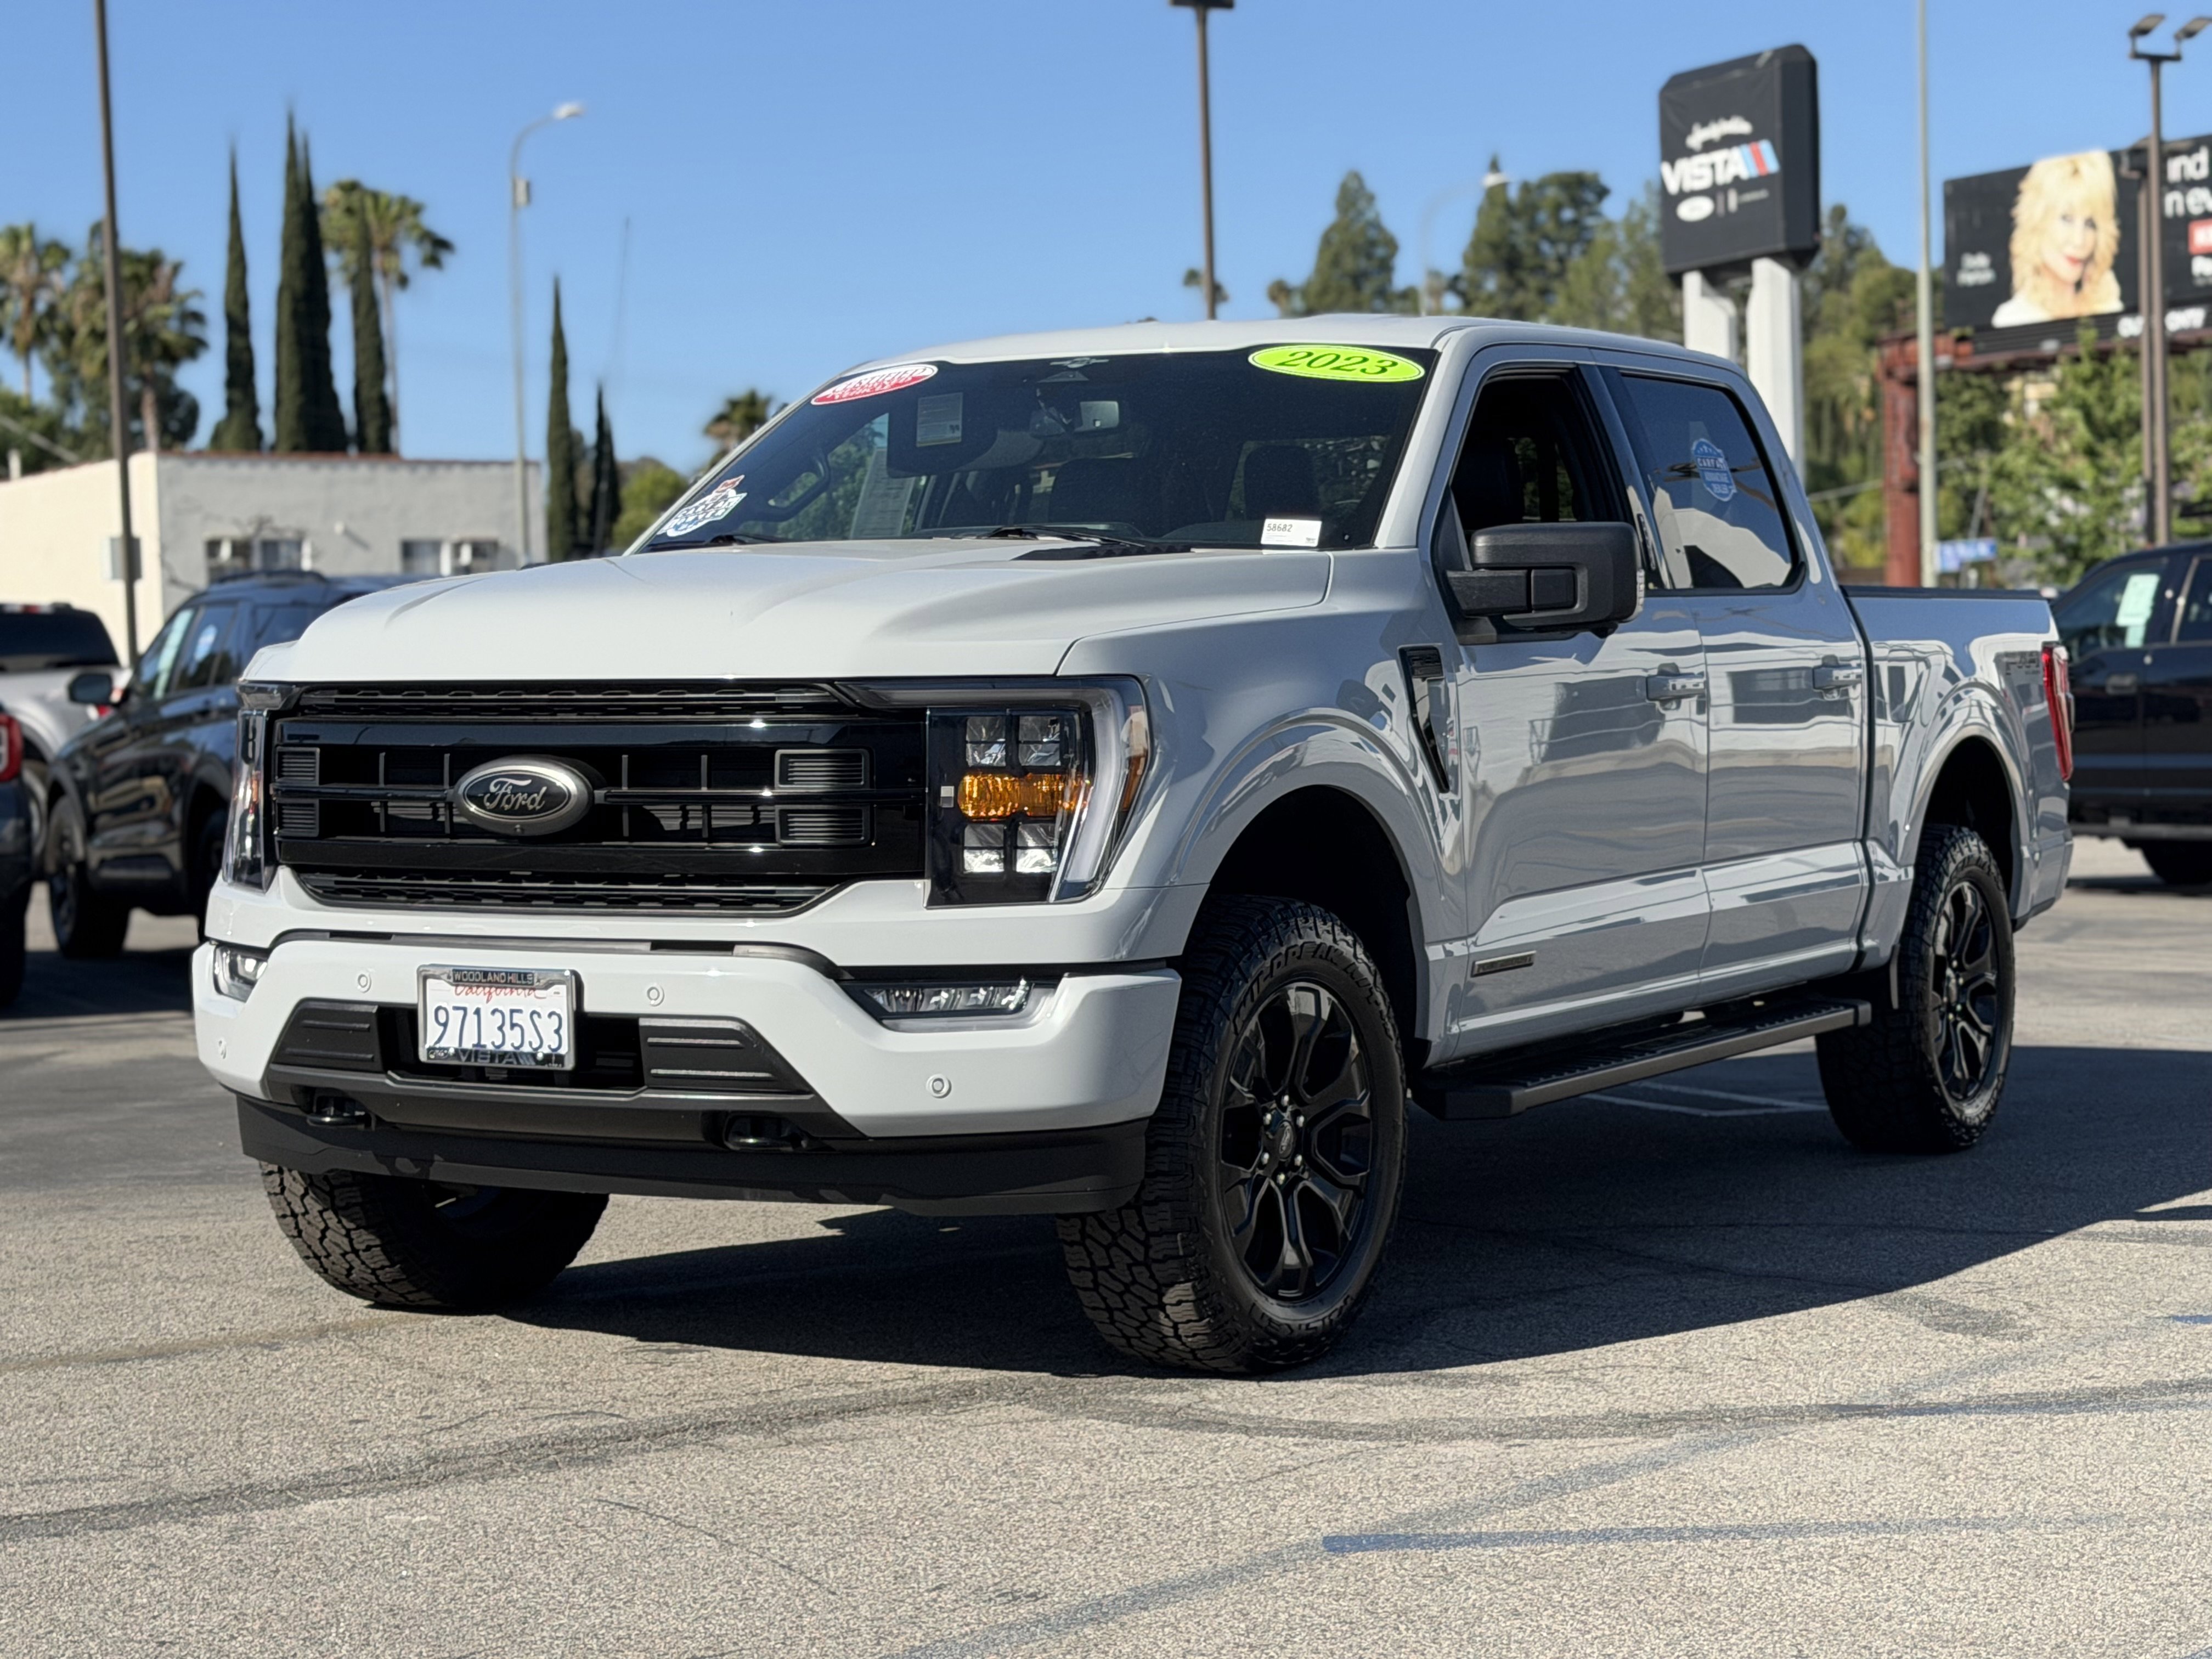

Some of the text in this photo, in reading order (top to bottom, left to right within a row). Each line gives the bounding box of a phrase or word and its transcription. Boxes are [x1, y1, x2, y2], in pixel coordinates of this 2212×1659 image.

[1660, 145, 1750, 196] VISTA
[1275, 351, 1399, 374] 2023
[1266, 523, 1293, 532] 58682
[483, 777, 548, 810] Ford
[453, 970, 534, 985] WOODLAND HILLS
[454, 984, 547, 1003] California
[433, 1005, 563, 1053] 97135S3
[458, 1049, 520, 1065] VISTA
